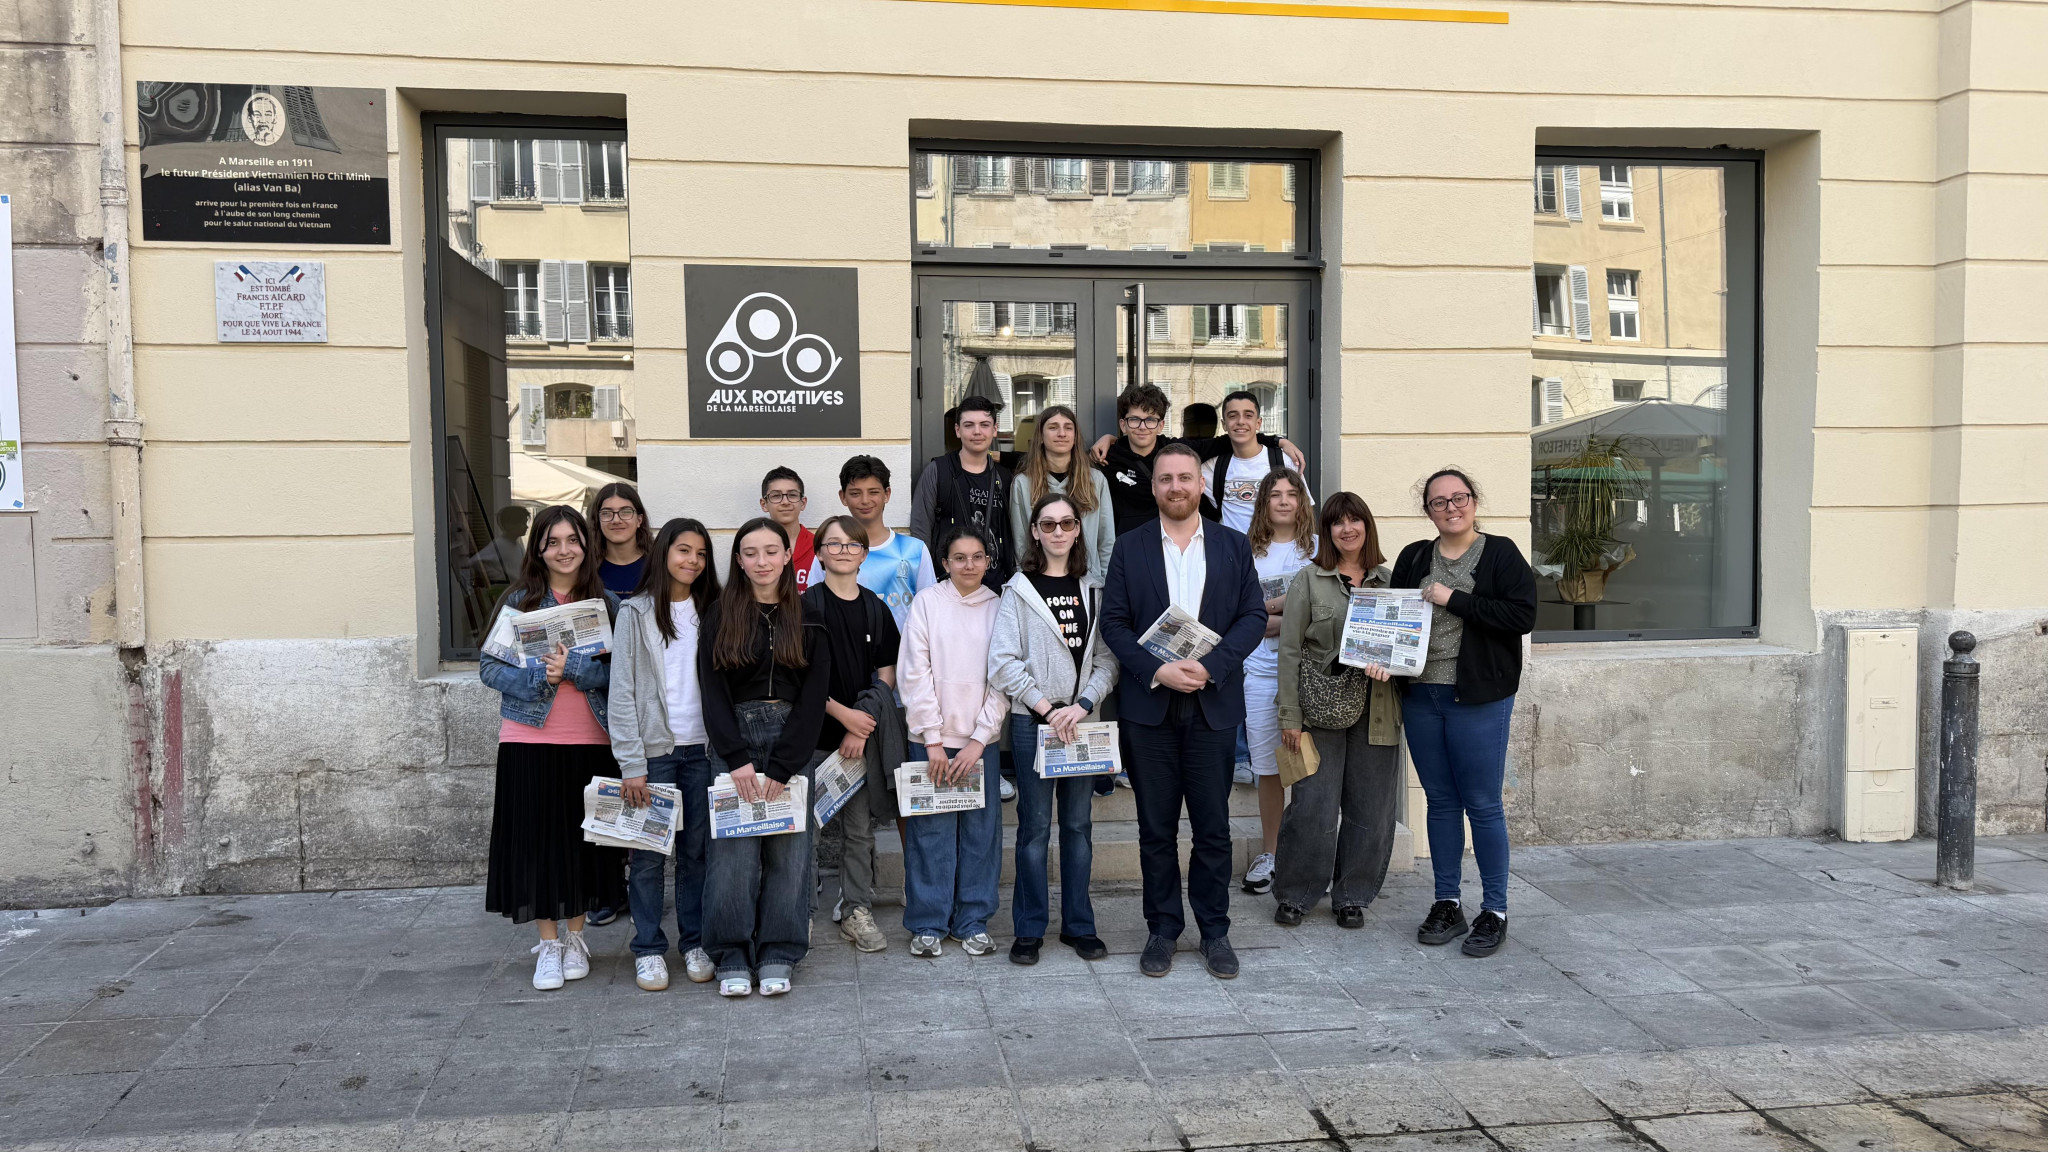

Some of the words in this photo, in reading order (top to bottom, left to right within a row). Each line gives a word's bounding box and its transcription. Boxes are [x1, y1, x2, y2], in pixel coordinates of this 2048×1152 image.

[219, 157, 226, 165] A
[229, 157, 274, 166] Marseille
[292, 159, 313, 167] 1911
[161, 168, 170, 176] le
[173, 169, 199, 177] futur
[202, 169, 249, 178] Président
[252, 171, 309, 180] Vietnamien
[312, 172, 325, 180] Ho
[328, 172, 343, 180] Chi
[346, 173, 371, 181] Minh
[234, 182, 261, 192] (alias
[263, 184, 282, 192] Van
[285, 184, 301, 194] Ba)
[273, 211, 290, 219] long
[265, 284, 291, 292] TOMBÉ
[271, 293, 306, 301] AICARD
[707, 389, 747, 405] AUX
[752, 389, 844, 406] ROTATIVES
[707, 404, 718, 412] DE
[720, 404, 732, 412] LA
[734, 405, 797, 413] MARSEILLAISE
[1046, 596, 1080, 608] FOCUS
[1059, 609, 1074, 620] ON
[1059, 622, 1078, 634] THE
[1149, 644, 1158, 652] La
[1053, 765, 1062, 773] La
[1062, 763, 1106, 772] Marseillaise
[826, 809, 835, 818] La
[725, 828, 735, 837] La
[736, 821, 786, 835] Marseillaise
